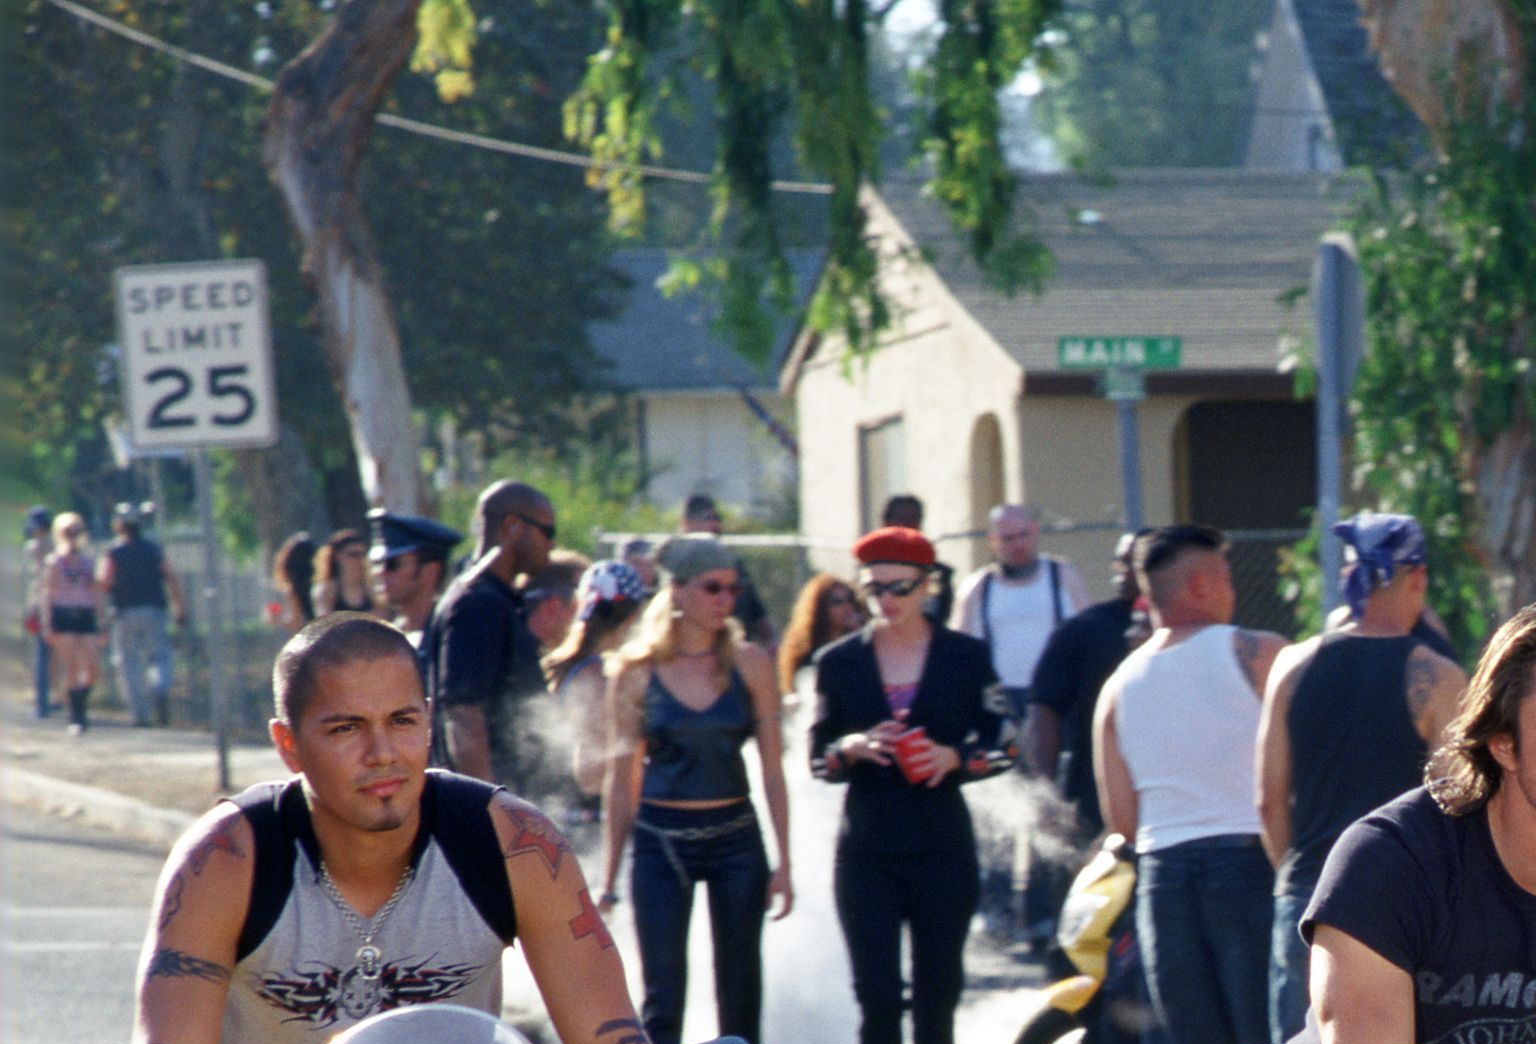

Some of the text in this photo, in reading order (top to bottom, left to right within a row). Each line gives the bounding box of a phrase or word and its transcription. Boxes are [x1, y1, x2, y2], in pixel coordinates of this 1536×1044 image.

[126, 279, 254, 314] SPEED
[142, 322, 242, 354] LIMIT
[1063, 340, 1145, 363] MAIN
[144, 365, 257, 429] 25
